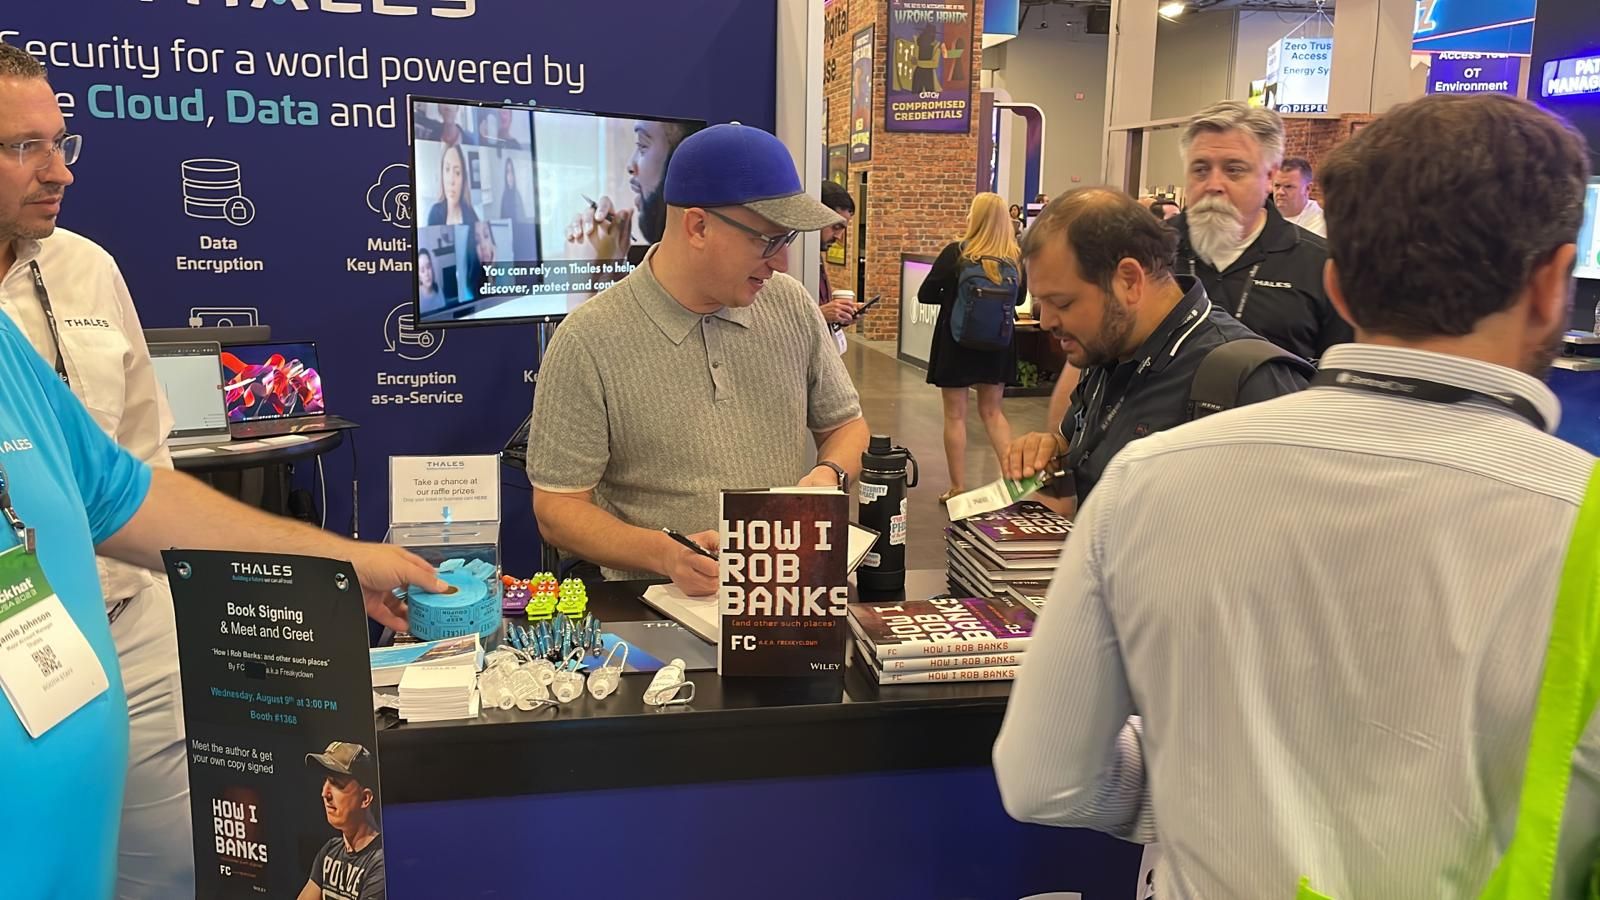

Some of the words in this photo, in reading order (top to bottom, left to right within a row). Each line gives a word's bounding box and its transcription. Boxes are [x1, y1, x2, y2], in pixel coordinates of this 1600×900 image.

[894, 9, 935, 24] WRONG
[936, 11, 969, 24] HANDS
[1284, 42, 1308, 50] Zero
[1310, 41, 1332, 50] Trus
[1291, 52, 1328, 60] Access
[170, 39, 225, 73] for
[235, 50, 254, 74] a
[266, 46, 369, 79] world
[381, 54, 532, 88] powered
[544, 54, 585, 94] by
[1283, 66, 1316, 76] Energy
[1317, 66, 1330, 76] Sy
[1463, 67, 1482, 78] OT
[1435, 80, 1509, 92] Environment
[919, 91, 940, 100] CATCH
[87, 84, 215, 129] Cloud,
[226, 89, 319, 126] Data
[330, 97, 396, 129] and
[892, 100, 966, 112] COMPROMISED
[1293, 104, 1328, 112] DISPEL
[894, 110, 963, 121] CREDENTIALS
[200, 235, 238, 250] Data
[367, 237, 412, 252] Multi-
[176, 256, 264, 274] Encryption
[346, 258, 376, 274] Key
[482, 265, 505, 277] You
[507, 267, 526, 276] can
[529, 263, 551, 278] rely
[553, 265, 567, 275] on
[569, 262, 601, 275] Thales
[602, 264, 613, 274] to
[614, 261, 636, 274] help
[479, 283, 530, 296] discover,
[532, 281, 570, 296] protect
[572, 279, 592, 291] and
[64, 319, 109, 328] THALES
[376, 371, 457, 388] Encryption
[371, 391, 464, 405] as-a-Service
[440, 478, 468, 486] chance
[431, 487, 450, 495] raffle
[451, 488, 475, 496] prizes
[721, 520, 801, 551] HOW
[814, 520, 832, 551] I
[230, 562, 293, 577] THALES
[721, 552, 801, 584] ROB
[721, 585, 849, 617] BANKS
[226, 602, 256, 617] Book
[258, 604, 303, 624] Signing
[873, 605, 904, 613] I
[20, 611, 52, 635] Johnson
[731, 619, 751, 628] (and
[753, 620, 778, 628] other
[780, 620, 801, 628] such
[803, 620, 836, 629] places)
[881, 616, 935, 645] HOW
[912, 613, 961, 644] ROB
[1004, 623, 1027, 635] FC
[220, 620, 229, 634] &
[231, 621, 257, 637] Meet
[259, 625, 280, 639] and
[282, 626, 314, 642] Greet
[731, 635, 757, 650] FC
[887, 648, 897, 656] FC
[923, 645, 944, 654] HOW
[947, 645, 952, 653] I
[955, 644, 974, 652] ROB
[977, 642, 1009, 651] BANKS
[230, 649, 242, 657] Rob
[243, 650, 263, 660] Banks:
[264, 653, 275, 661] and
[276, 654, 291, 663] other
[292, 656, 307, 665] such
[895, 661, 905, 669] FC
[930, 659, 951, 667] HOW
[954, 658, 959, 666] I
[962, 657, 980, 665] ROB
[984, 655, 1015, 664] BANKS
[228, 662, 236, 671] By
[236, 663, 245, 672] FC
[280, 667, 314, 678] Freakyclown
[810, 662, 841, 670] WILEY
[928, 672, 949, 681] HOW
[952, 671, 957, 679] I
[961, 671, 979, 679] ROB
[983, 669, 1015, 678] BANKS
[210, 686, 255, 702] Wednesday,
[256, 692, 283, 705] August
[296, 699, 304, 707] at
[305, 698, 322, 709] 3:00
[324, 700, 338, 711] PM
[250, 709, 273, 721] Booth
[192, 739, 210, 752] Meet
[211, 742, 224, 754] the
[225, 745, 250, 758] author
[251, 748, 258, 759] &
[259, 751, 273, 762] get
[192, 753, 209, 763] your
[209, 756, 226, 767] own
[227, 759, 246, 772] copy
[247, 761, 274, 774] signed
[212, 798, 245, 821] HOW
[248, 804, 258, 824] I
[213, 817, 246, 840] ROB
[215, 835, 268, 863] BANKS
[220, 864, 232, 876] FC
